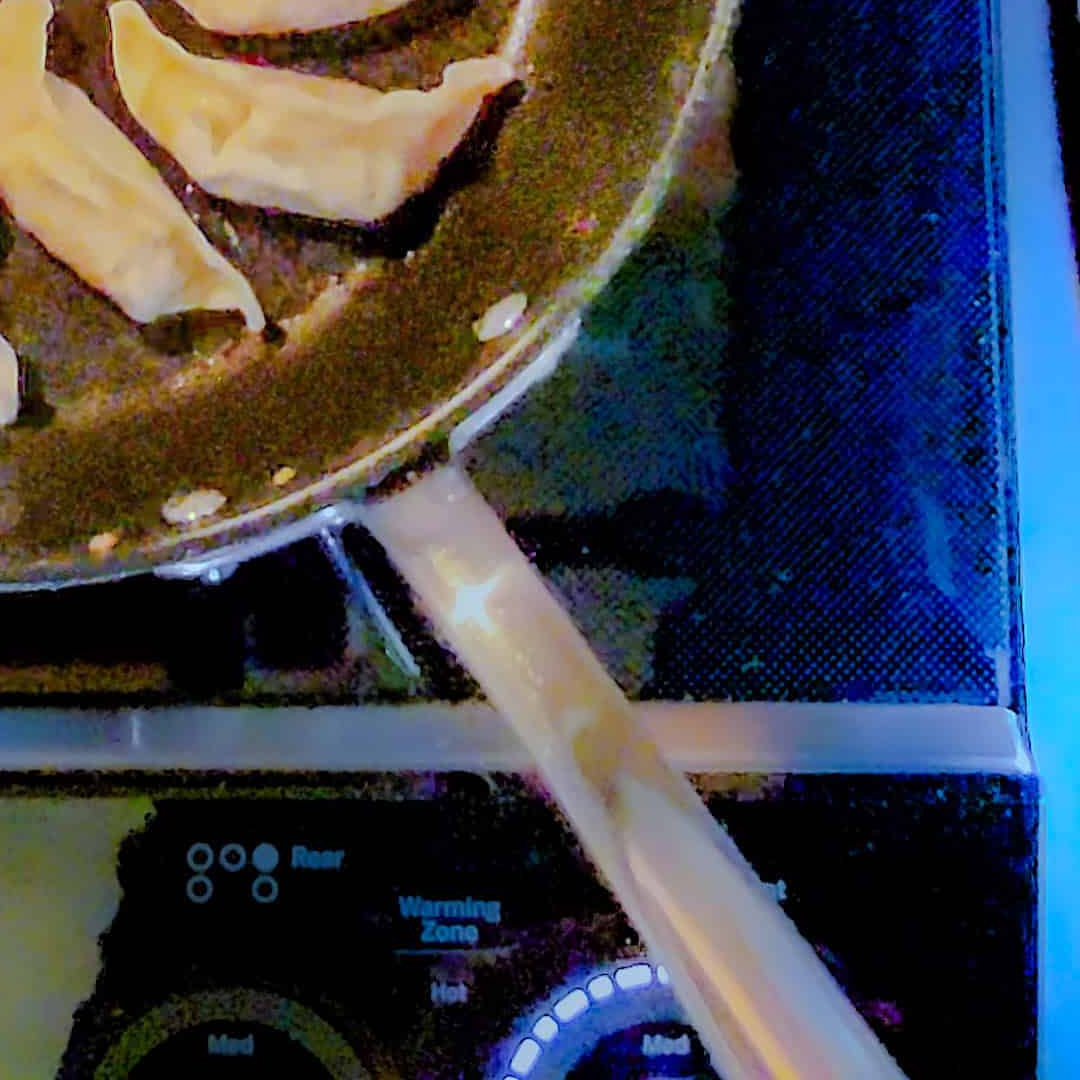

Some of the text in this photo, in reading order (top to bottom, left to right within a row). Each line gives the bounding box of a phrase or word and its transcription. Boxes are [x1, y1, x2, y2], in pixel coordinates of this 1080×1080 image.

[291, 846, 344, 871] Rear
[398, 895, 501, 924] Warming
[420, 919, 480, 944] Zone
[207, 1033, 254, 1056] Med
